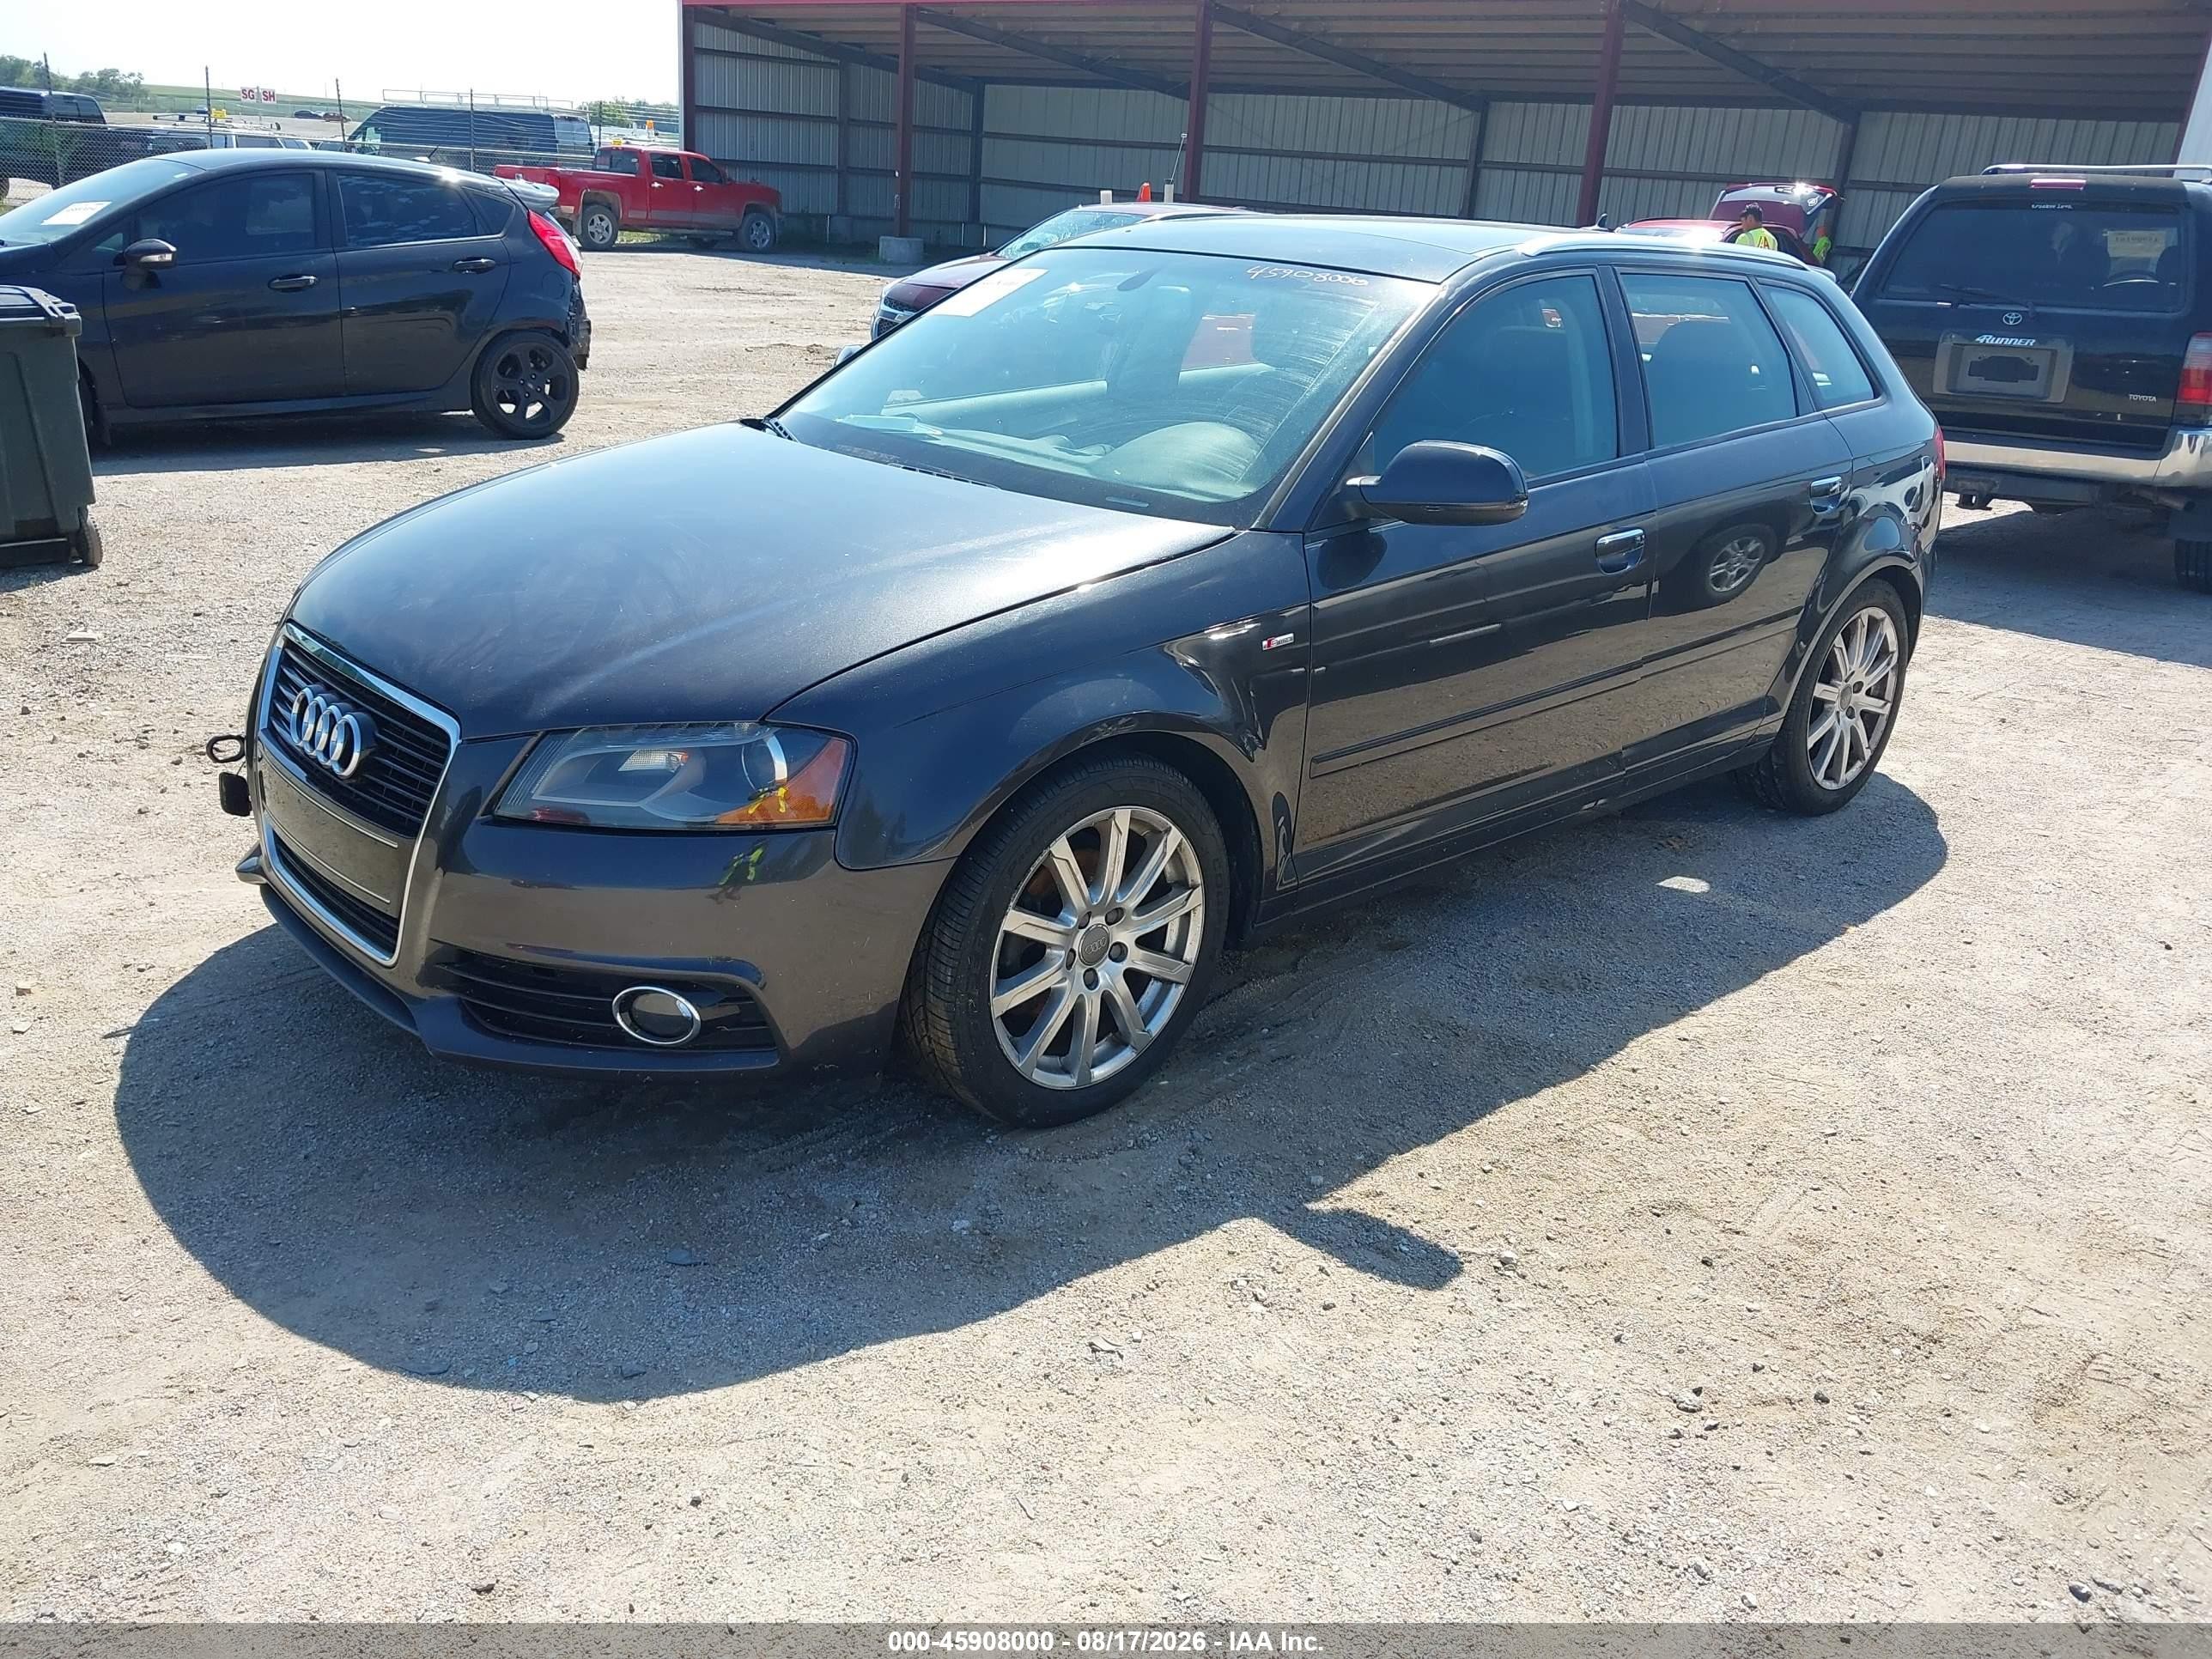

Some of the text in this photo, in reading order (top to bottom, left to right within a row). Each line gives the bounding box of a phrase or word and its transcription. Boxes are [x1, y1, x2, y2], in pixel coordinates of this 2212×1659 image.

[241, 88, 255, 100] SG
[262, 90, 276, 101] SH
[2129, 393, 2157, 402] TOYOTA
